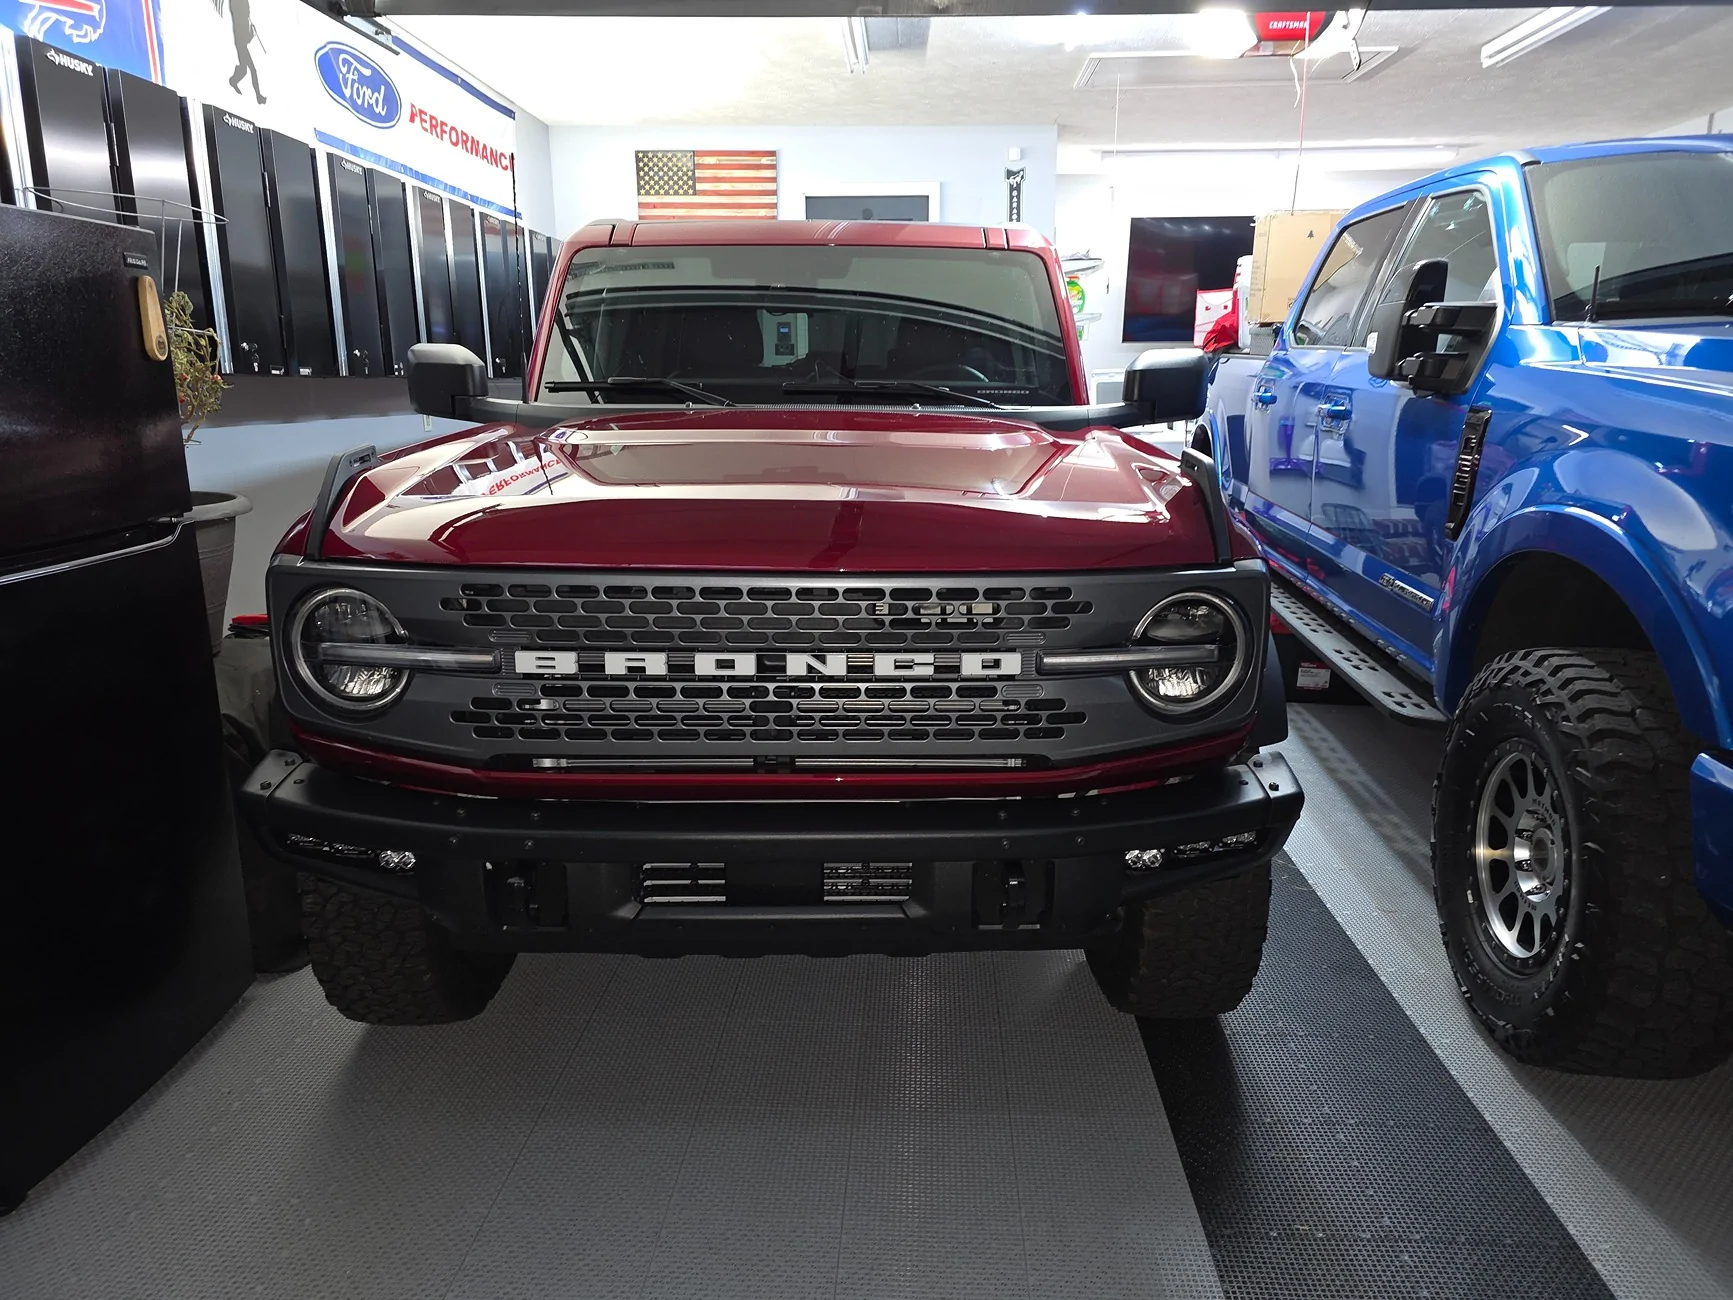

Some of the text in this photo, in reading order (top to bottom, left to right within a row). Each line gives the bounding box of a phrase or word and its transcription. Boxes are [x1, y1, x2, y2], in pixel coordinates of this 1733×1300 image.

[59, 53, 94, 76] HUSKY
[339, 53, 387, 117] Ford
[231, 116, 254, 134] HUSKY
[515, 651, 1022, 675] BRONCO
